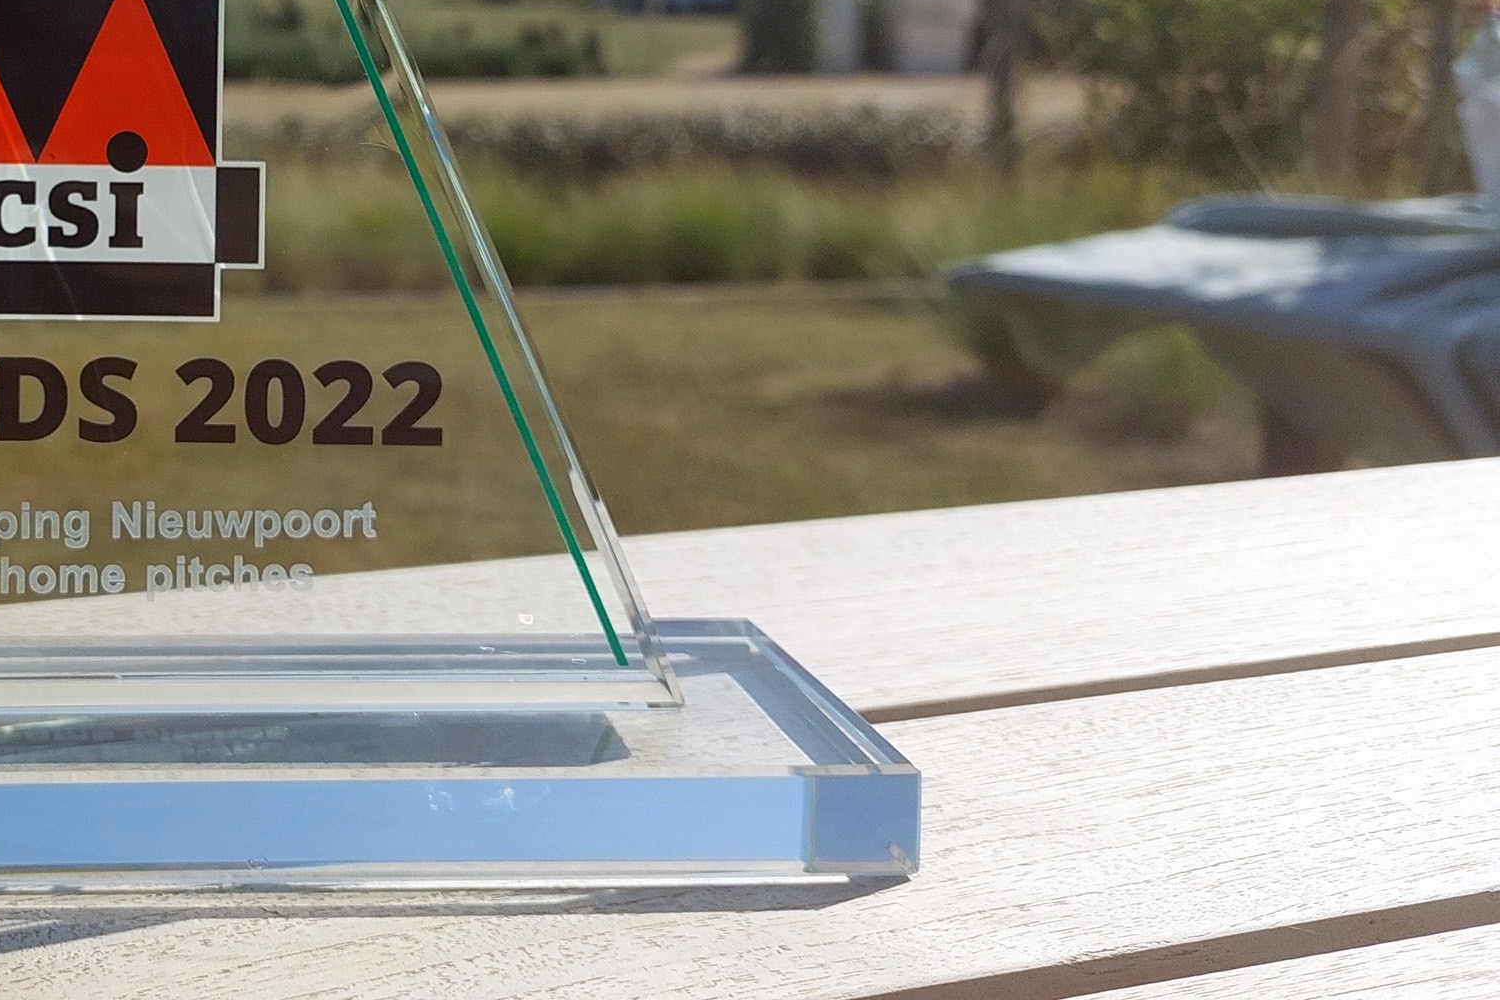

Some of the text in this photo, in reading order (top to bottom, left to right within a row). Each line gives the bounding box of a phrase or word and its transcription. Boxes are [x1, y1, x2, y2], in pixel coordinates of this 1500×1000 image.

[173, 357, 444, 446] 2022
[111, 499, 378, 546] Nieuwpoort
[146, 554, 315, 602] pitches
